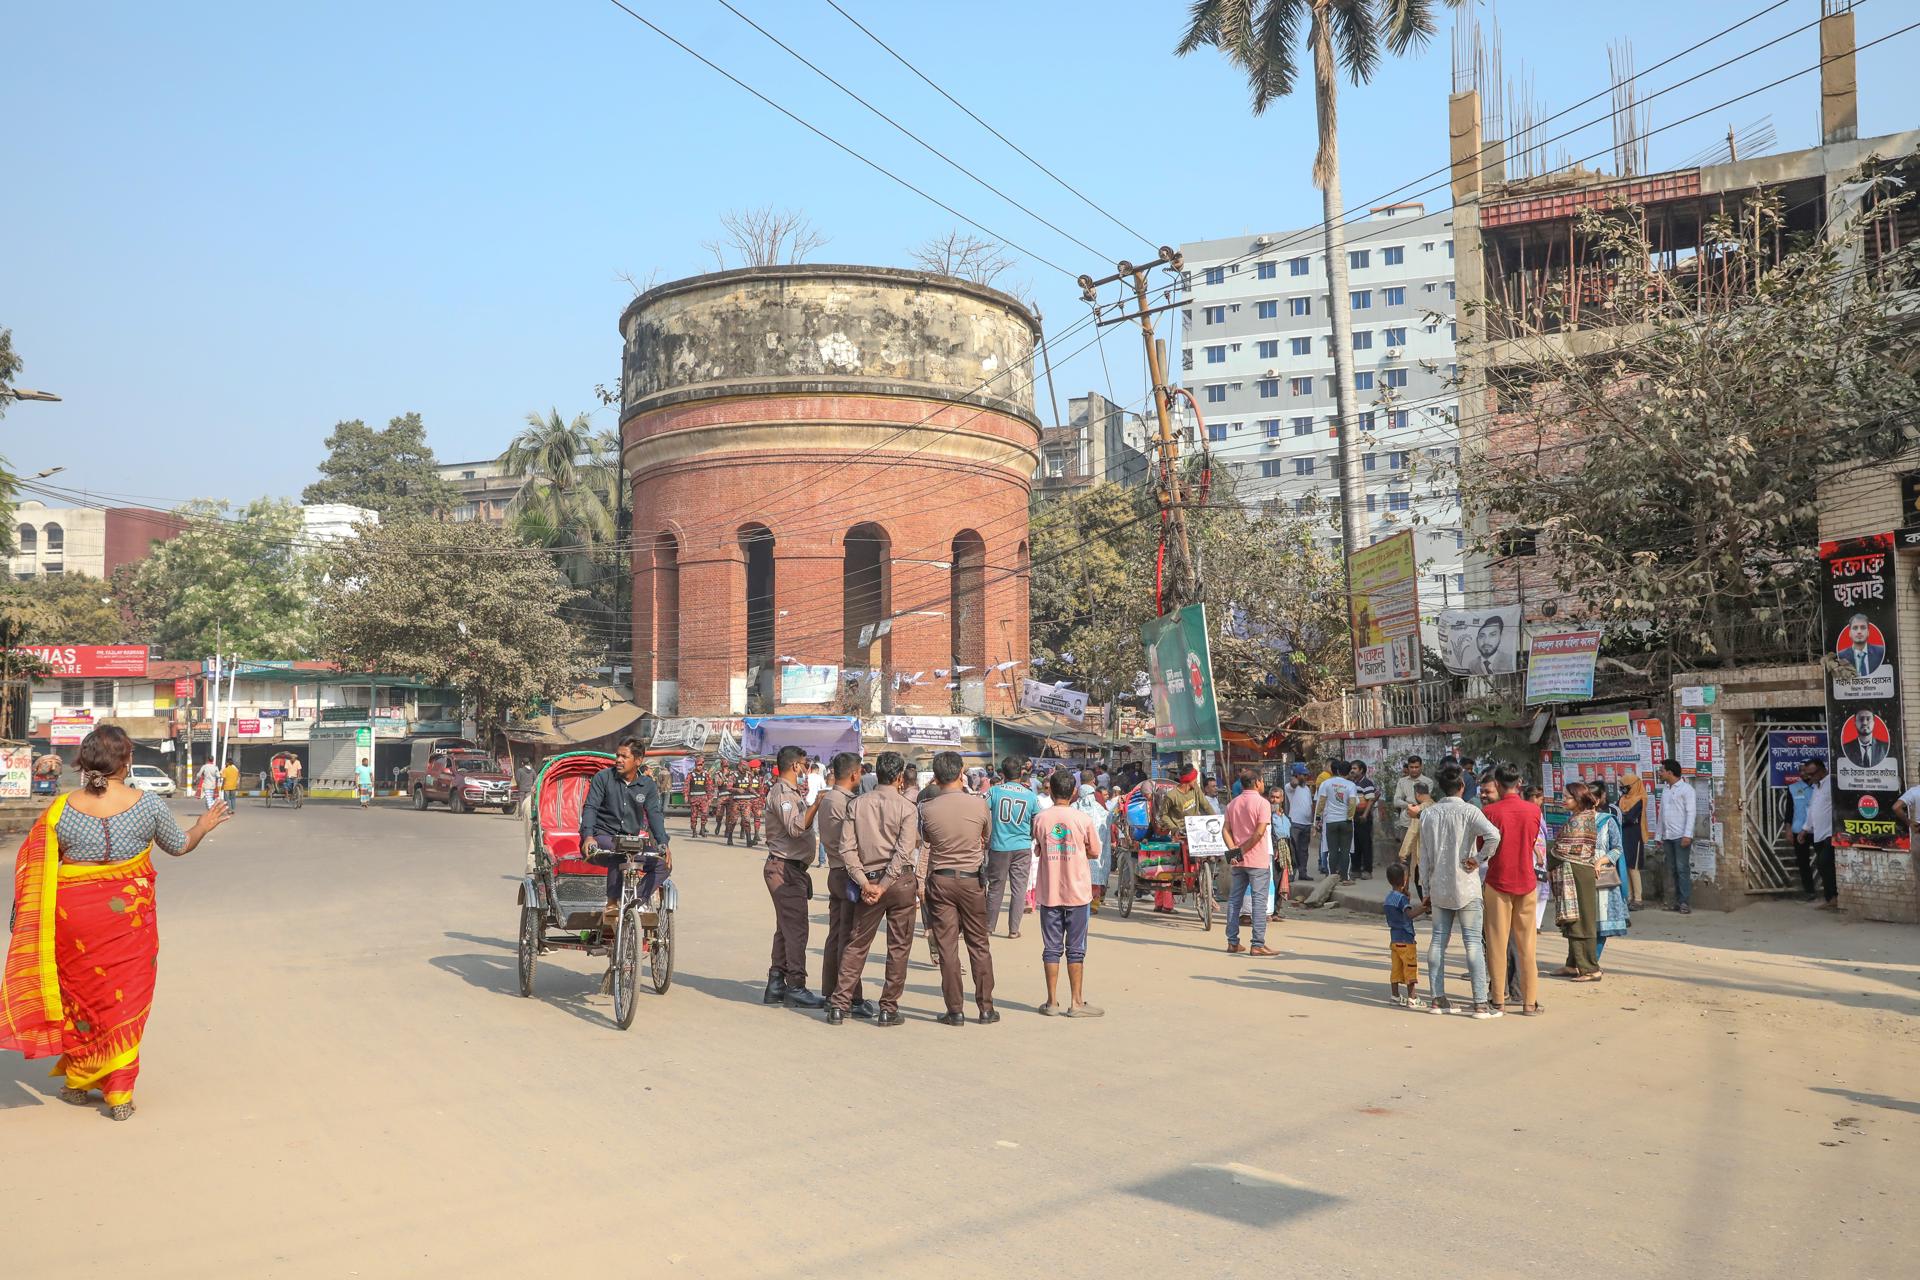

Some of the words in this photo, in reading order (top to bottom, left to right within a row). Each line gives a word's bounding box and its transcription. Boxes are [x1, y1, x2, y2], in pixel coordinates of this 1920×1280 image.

[1830, 553, 1885, 579] রক্তাক্ত
[1833, 575, 1884, 607] জুলাই
[1363, 647, 1385, 662] বেঙ্গল
[1871, 676, 1892, 685] হোসেন
[1561, 727, 1598, 740] মানবতার
[1600, 725, 1629, 738] দেয়াল
[1787, 735, 1817, 744] ঘোষণা
[1771, 747, 1799, 757] ক্যাম্পাসে
[1775, 761, 1794, 771] প্রবেশ
[1000, 797, 1027, 826] 07
[1844, 819, 1896, 836] ছাত্রদল
